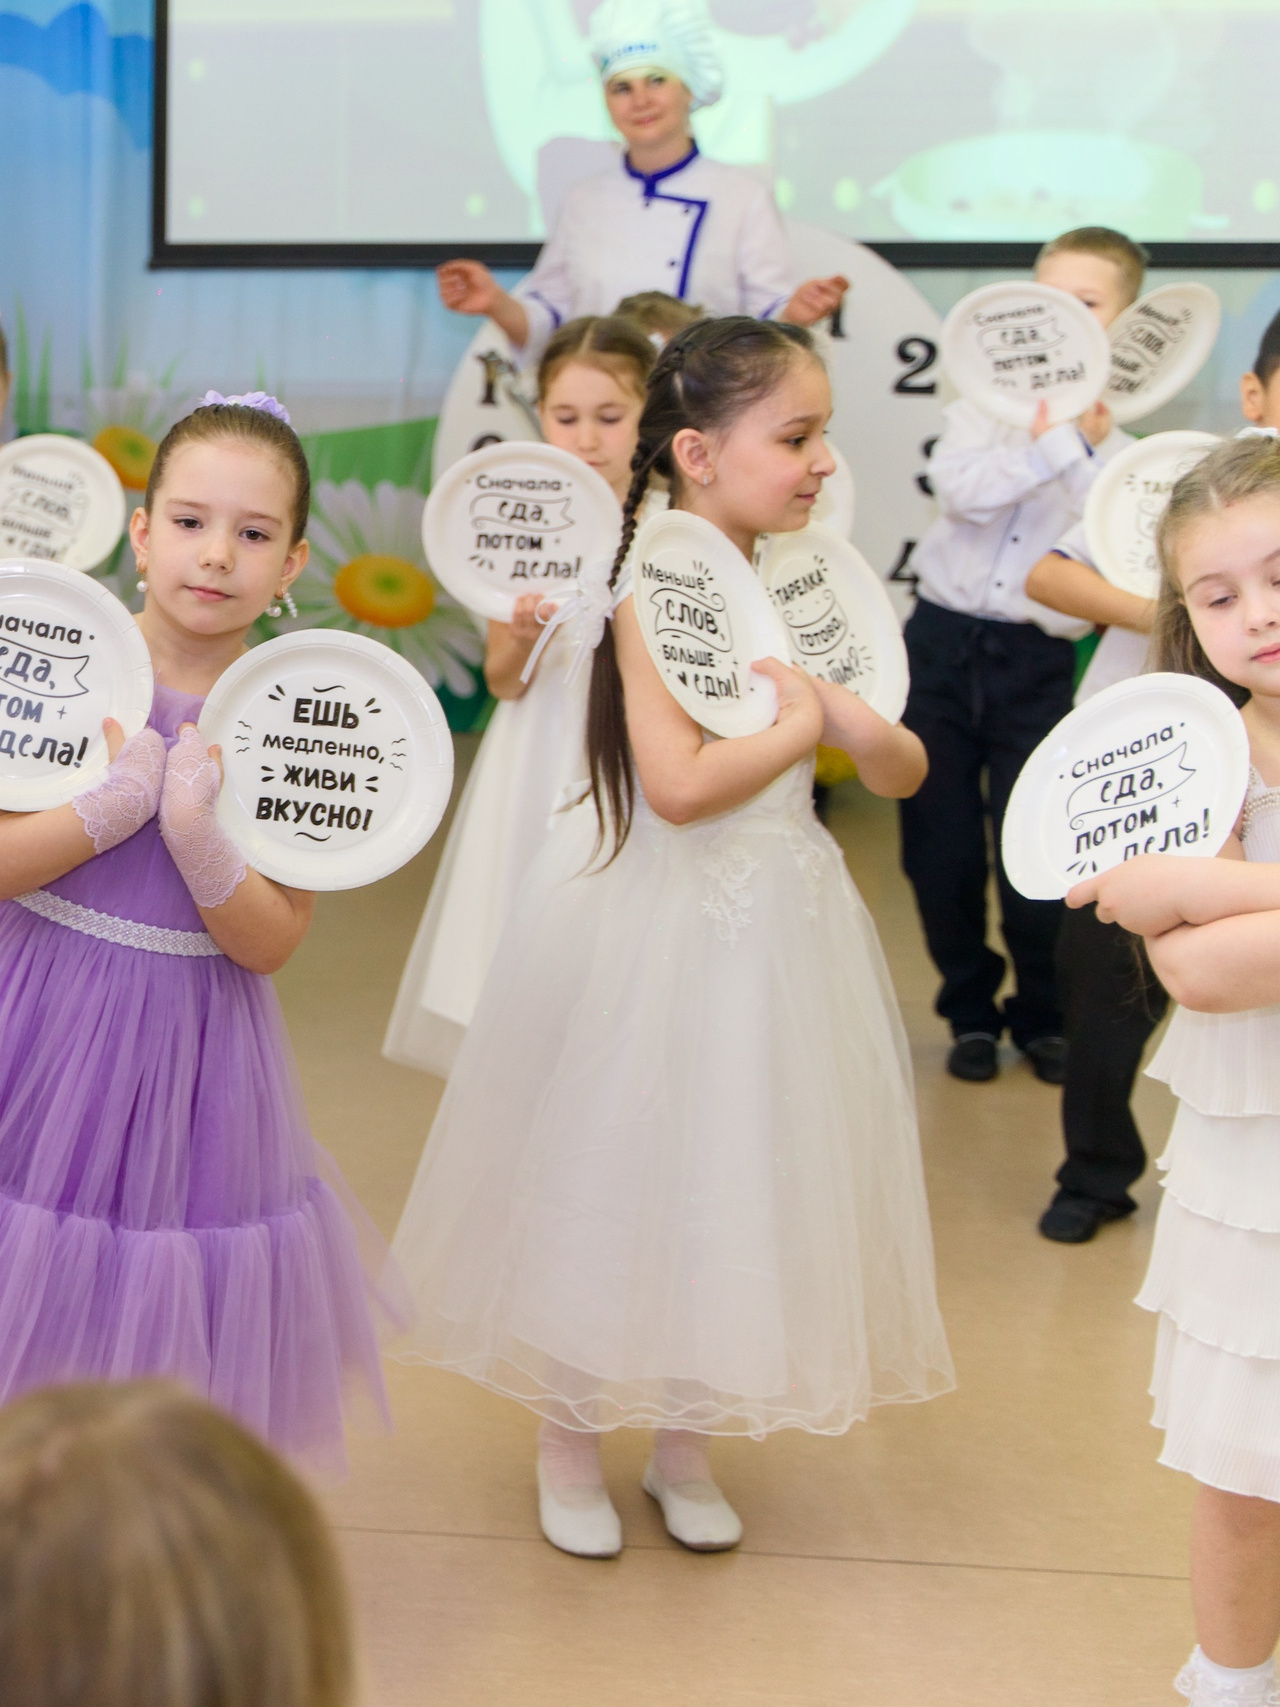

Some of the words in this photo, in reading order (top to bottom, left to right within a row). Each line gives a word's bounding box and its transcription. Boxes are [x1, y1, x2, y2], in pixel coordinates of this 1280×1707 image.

[893, 336, 938, 395] 2
[476, 474, 562, 491] Сначала
[510, 556, 583, 580] дела!
[642, 562, 706, 591] Меньше
[775, 569, 827, 606] ТАРЕЛКА
[694, 671, 741, 700] еды!
[293, 697, 360, 730] ЕШЬ
[262, 734, 385, 764] медленно,
[1071, 725, 1175, 779] Сначала
[1100, 768, 1164, 806] еда,
[255, 797, 374, 832] ВКУСНО!
